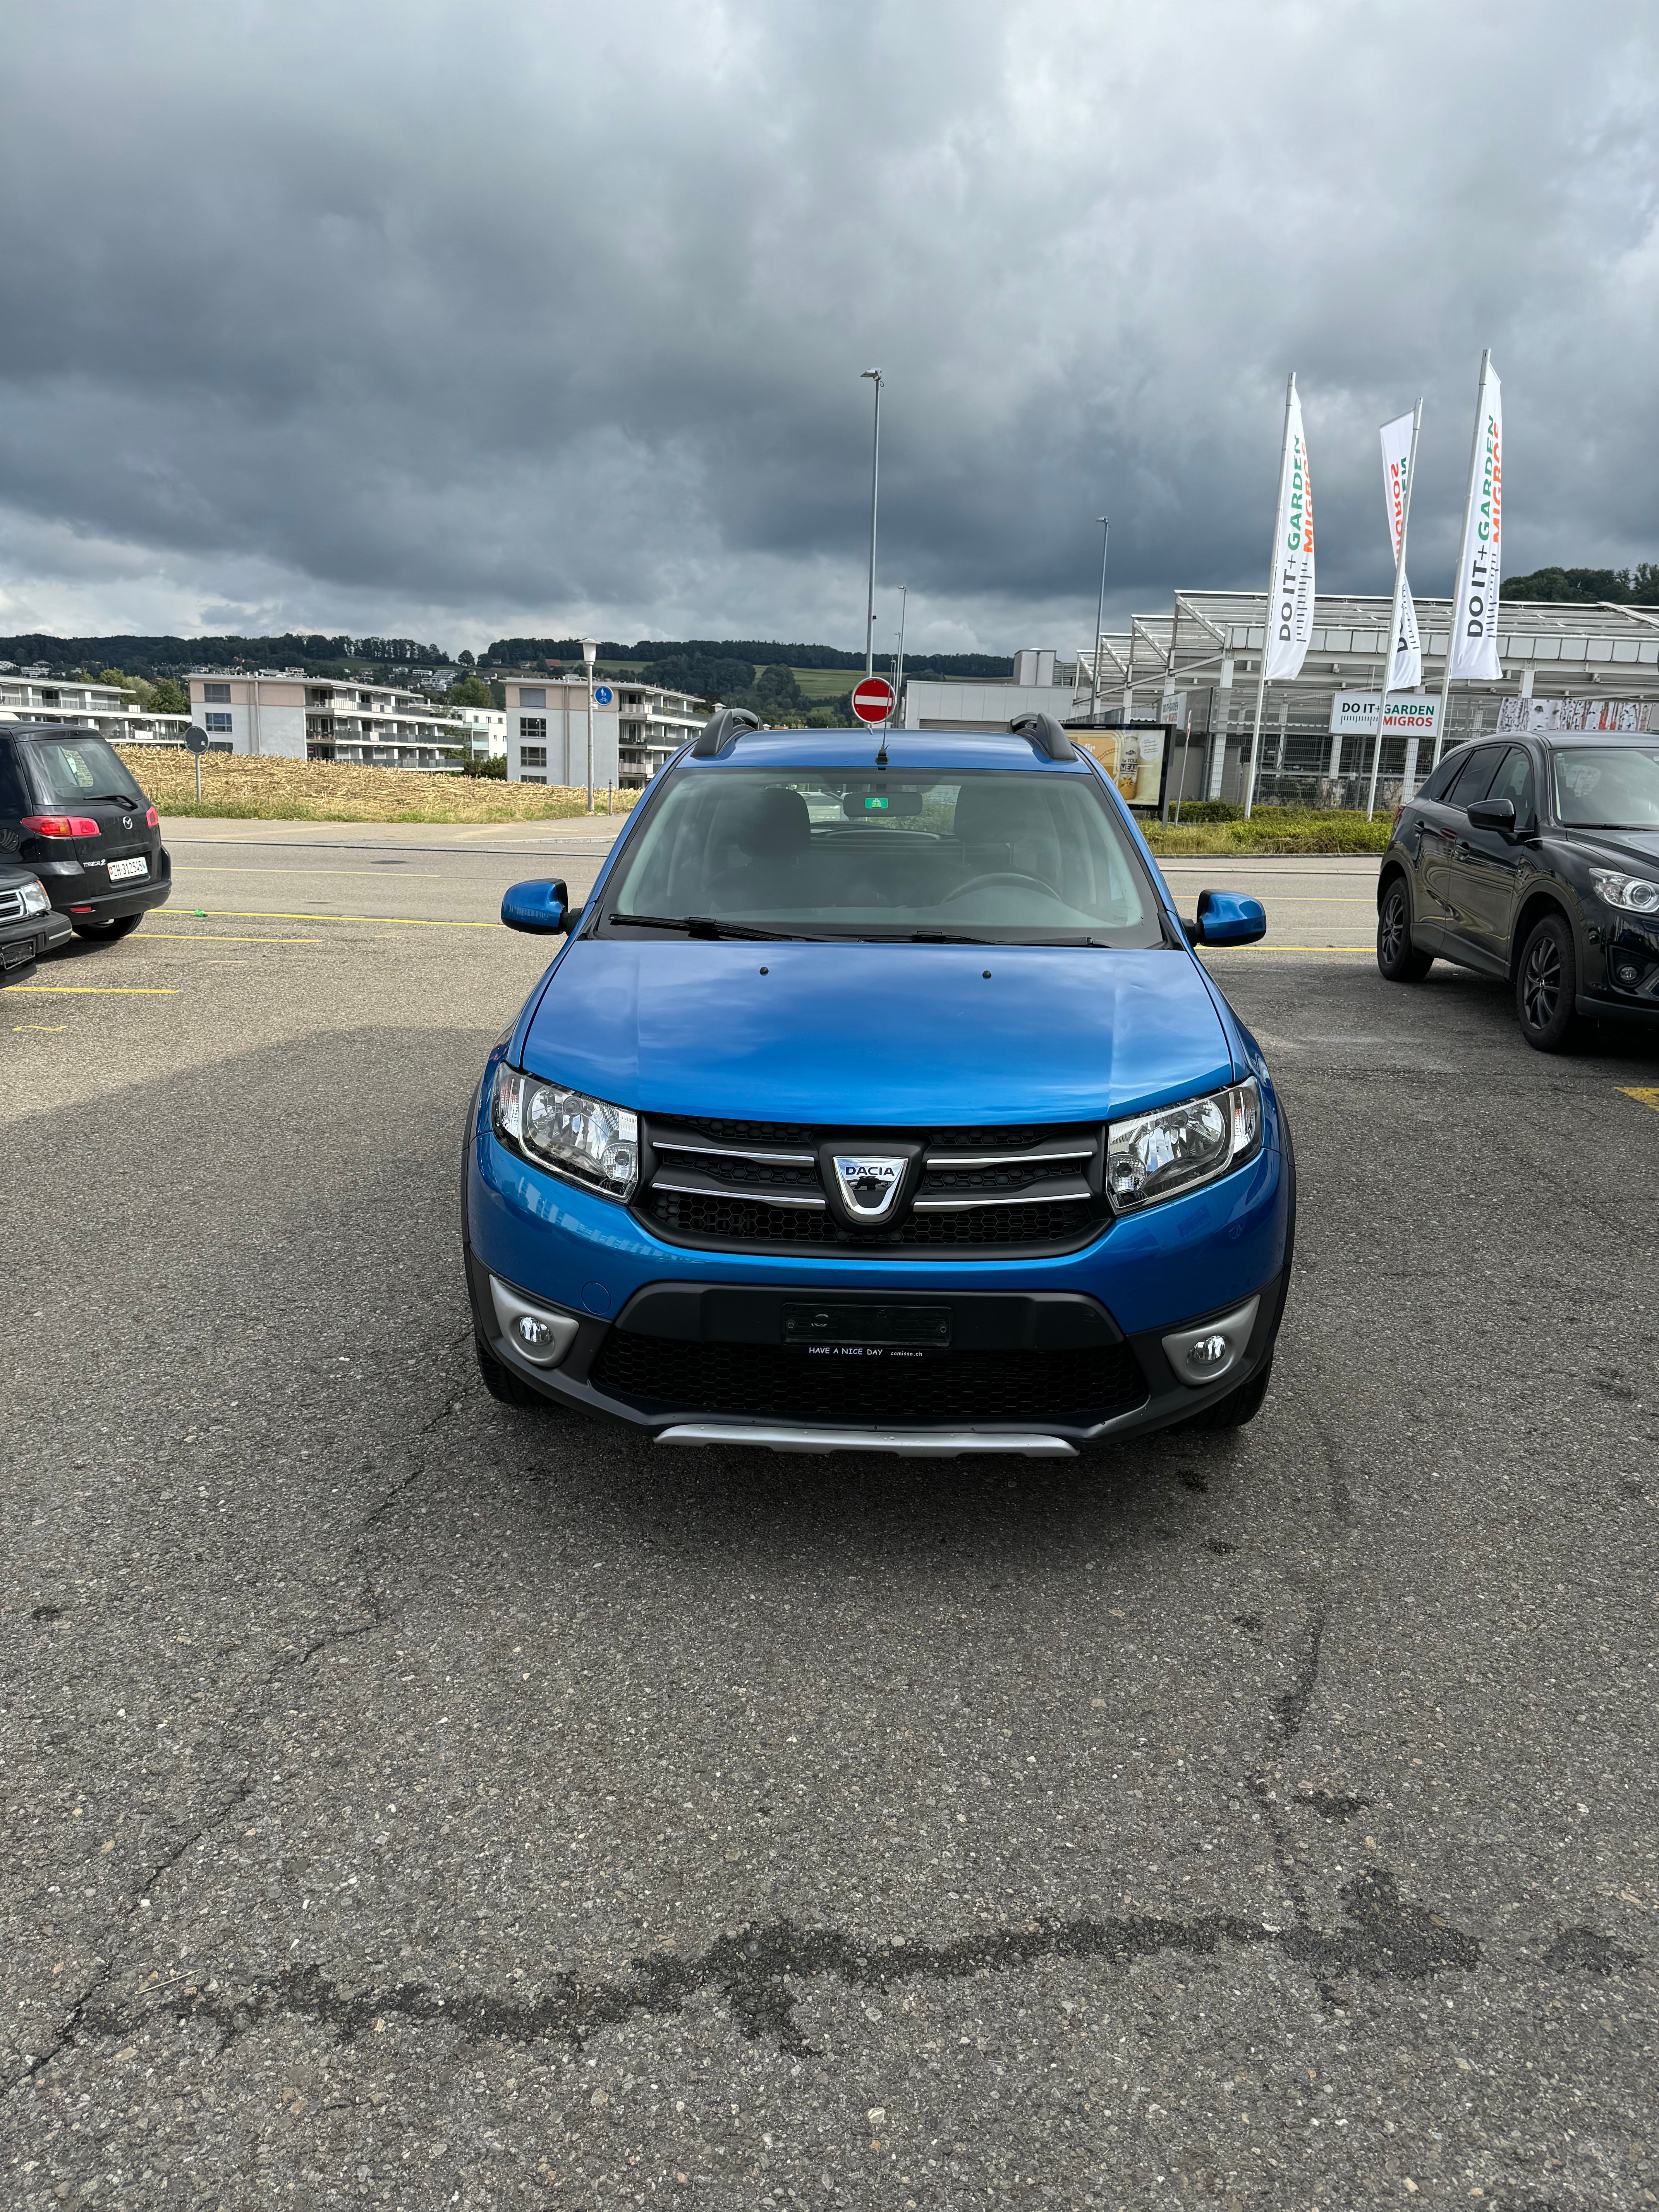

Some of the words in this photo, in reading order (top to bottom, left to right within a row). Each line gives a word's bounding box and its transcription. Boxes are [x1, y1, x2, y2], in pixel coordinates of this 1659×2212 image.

[1467, 596, 1483, 637] DO
[1478, 415, 1494, 541] GARDEN
[1279, 602, 1292, 641] DO
[1288, 434, 1302, 550] GARDEN
[1342, 703, 1360, 713] DO
[1384, 704, 1434, 716] GARDEN
[1383, 716, 1433, 727] MIGROS
[846, 1166, 895, 1176] DACIA
